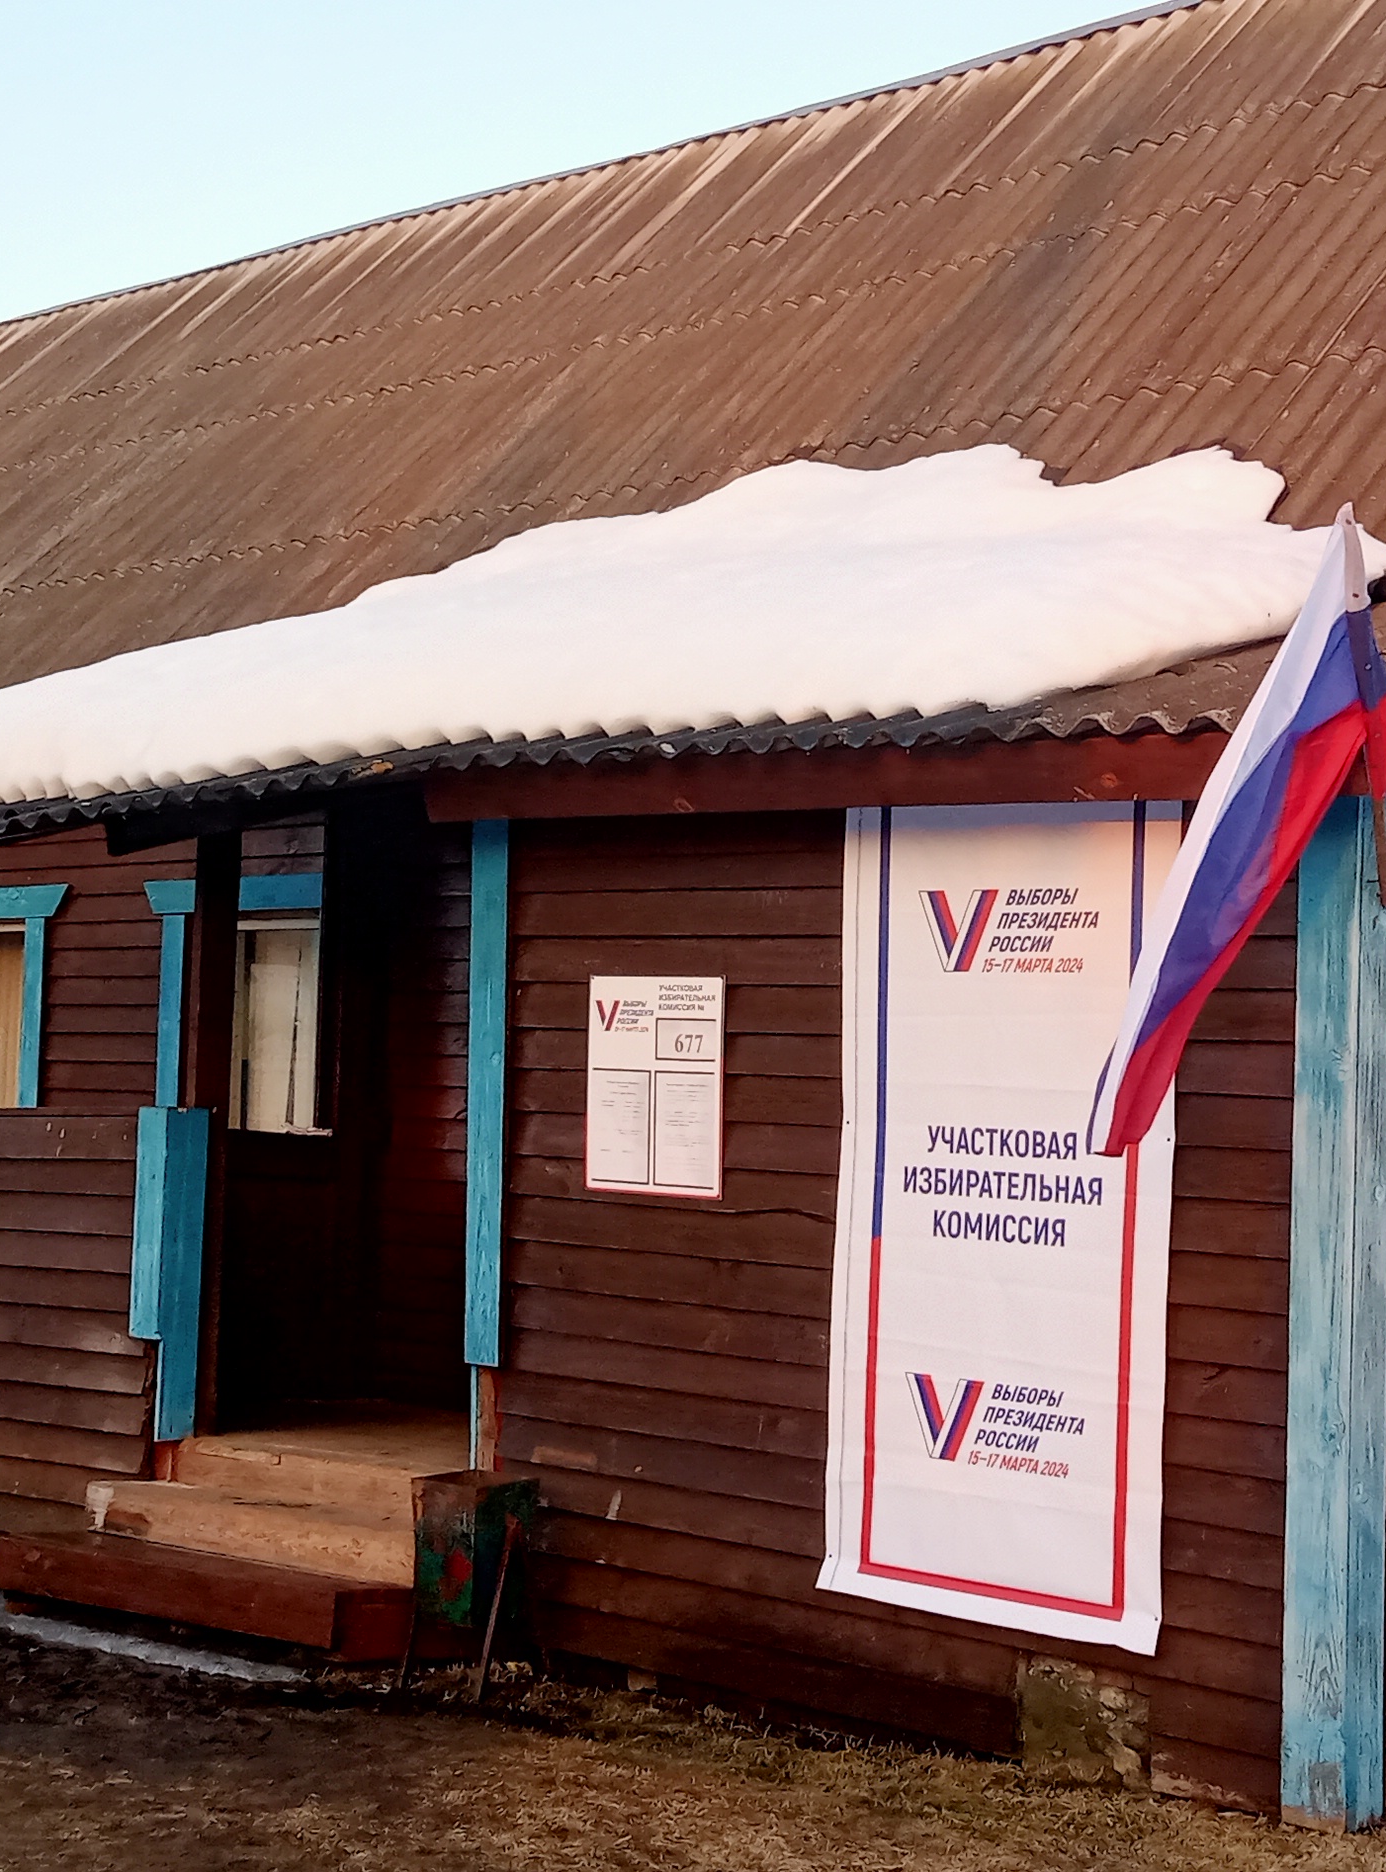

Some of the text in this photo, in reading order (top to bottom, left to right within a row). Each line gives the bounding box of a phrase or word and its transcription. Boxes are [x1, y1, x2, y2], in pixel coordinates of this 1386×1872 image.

[1005, 887, 1080, 907] ВЫБОРЫ
[997, 911, 1101, 931] ПРЕЗИДЕНТА
[988, 935, 1055, 953] РОССИИ
[1015, 958, 1053, 974] МАРТА
[1054, 957, 1084, 974] 2024
[658, 984, 704, 993] УЧАСТКОВАЯ
[658, 993, 717, 1003] ИЗБИРАТЕЛЬНАЯ
[658, 1003, 696, 1012] КОМИССИЯ
[674, 1033, 704, 1054] 677
[927, 1125, 1078, 1161] УЧАСТКОВАЯ
[903, 1166, 1103, 1206] ИЗБИРАТЕЛЬНАЯ
[933, 1209, 1066, 1248] КОМИССИЯ
[991, 1383, 1065, 1408] ВЫБОРЫ
[982, 1406, 1086, 1436] ПРЕЗИДЕНТА
[974, 1428, 1040, 1454] РОССИИ
[999, 1454, 1039, 1475] МАРТА
[1040, 1460, 1070, 1479] 2024
